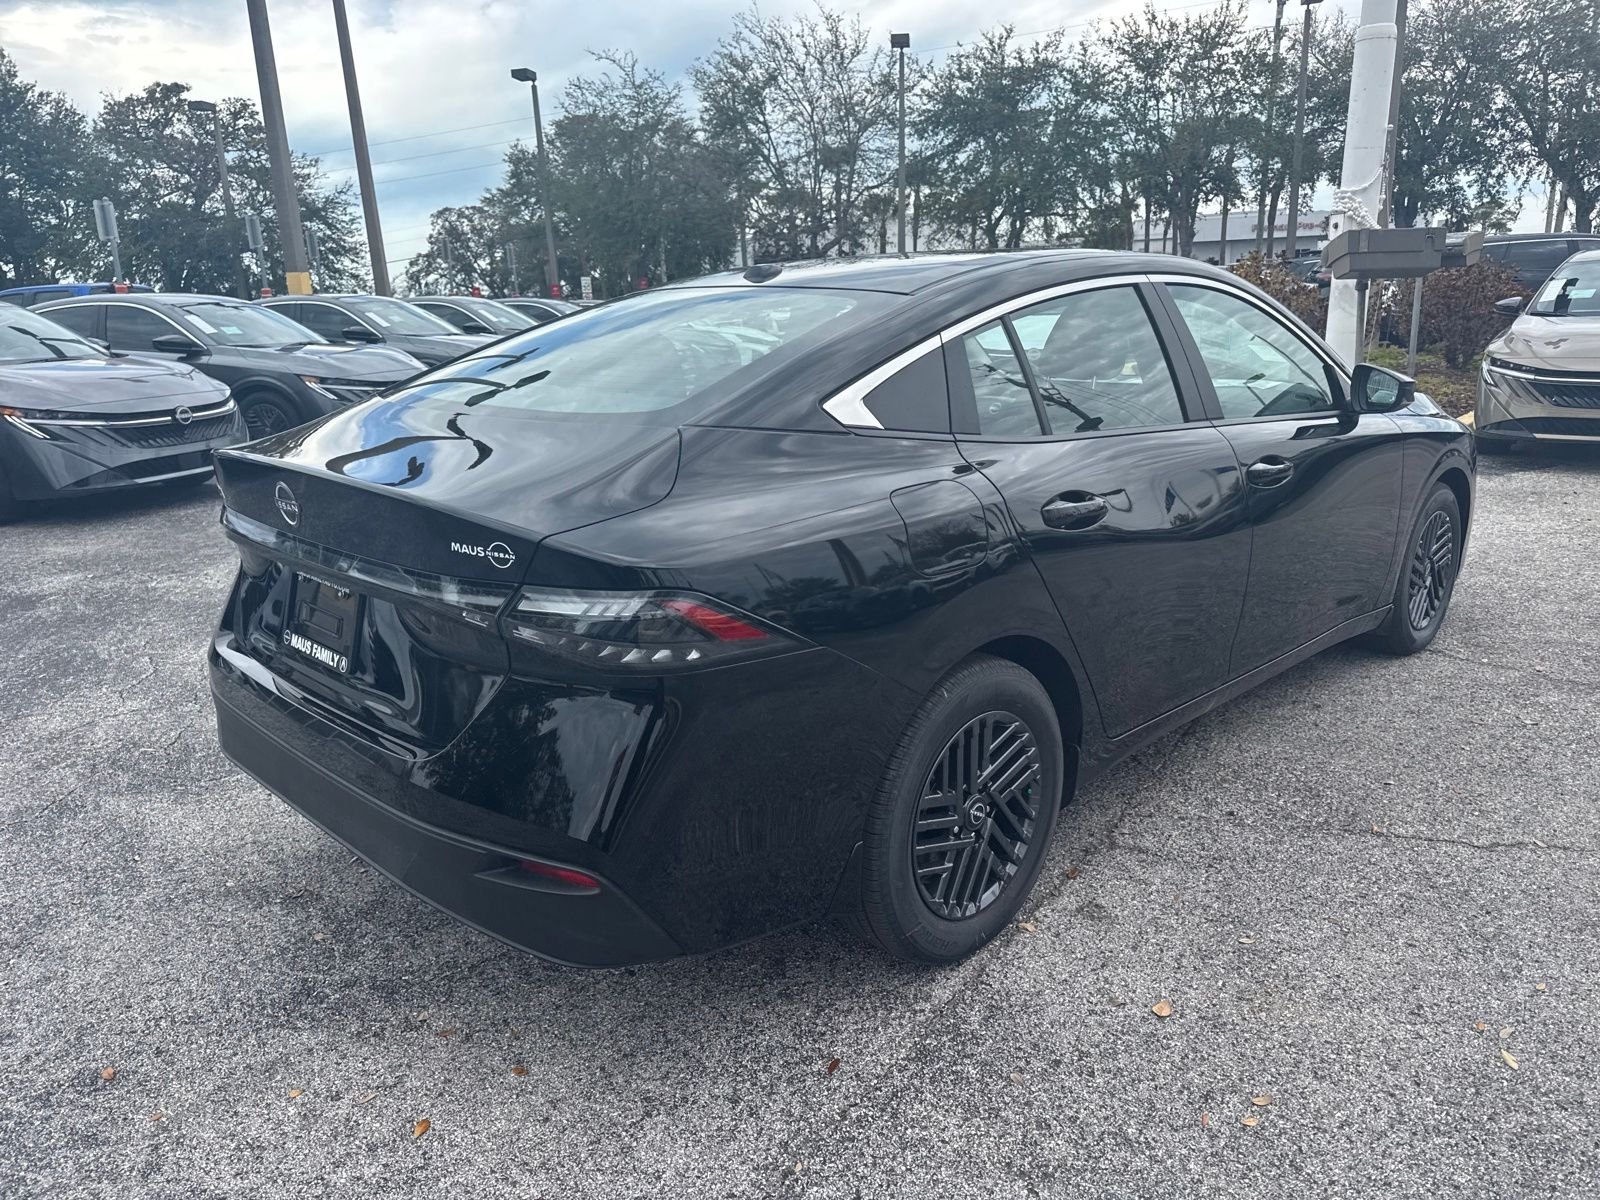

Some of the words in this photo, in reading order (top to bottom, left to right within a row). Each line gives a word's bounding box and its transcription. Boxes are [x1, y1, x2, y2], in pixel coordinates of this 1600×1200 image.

[451, 542, 485, 557] MAUS
[486, 551, 515, 560] NISSAN
[290, 633, 312, 655] MAUS
[311, 643, 340, 668] FAMILY
